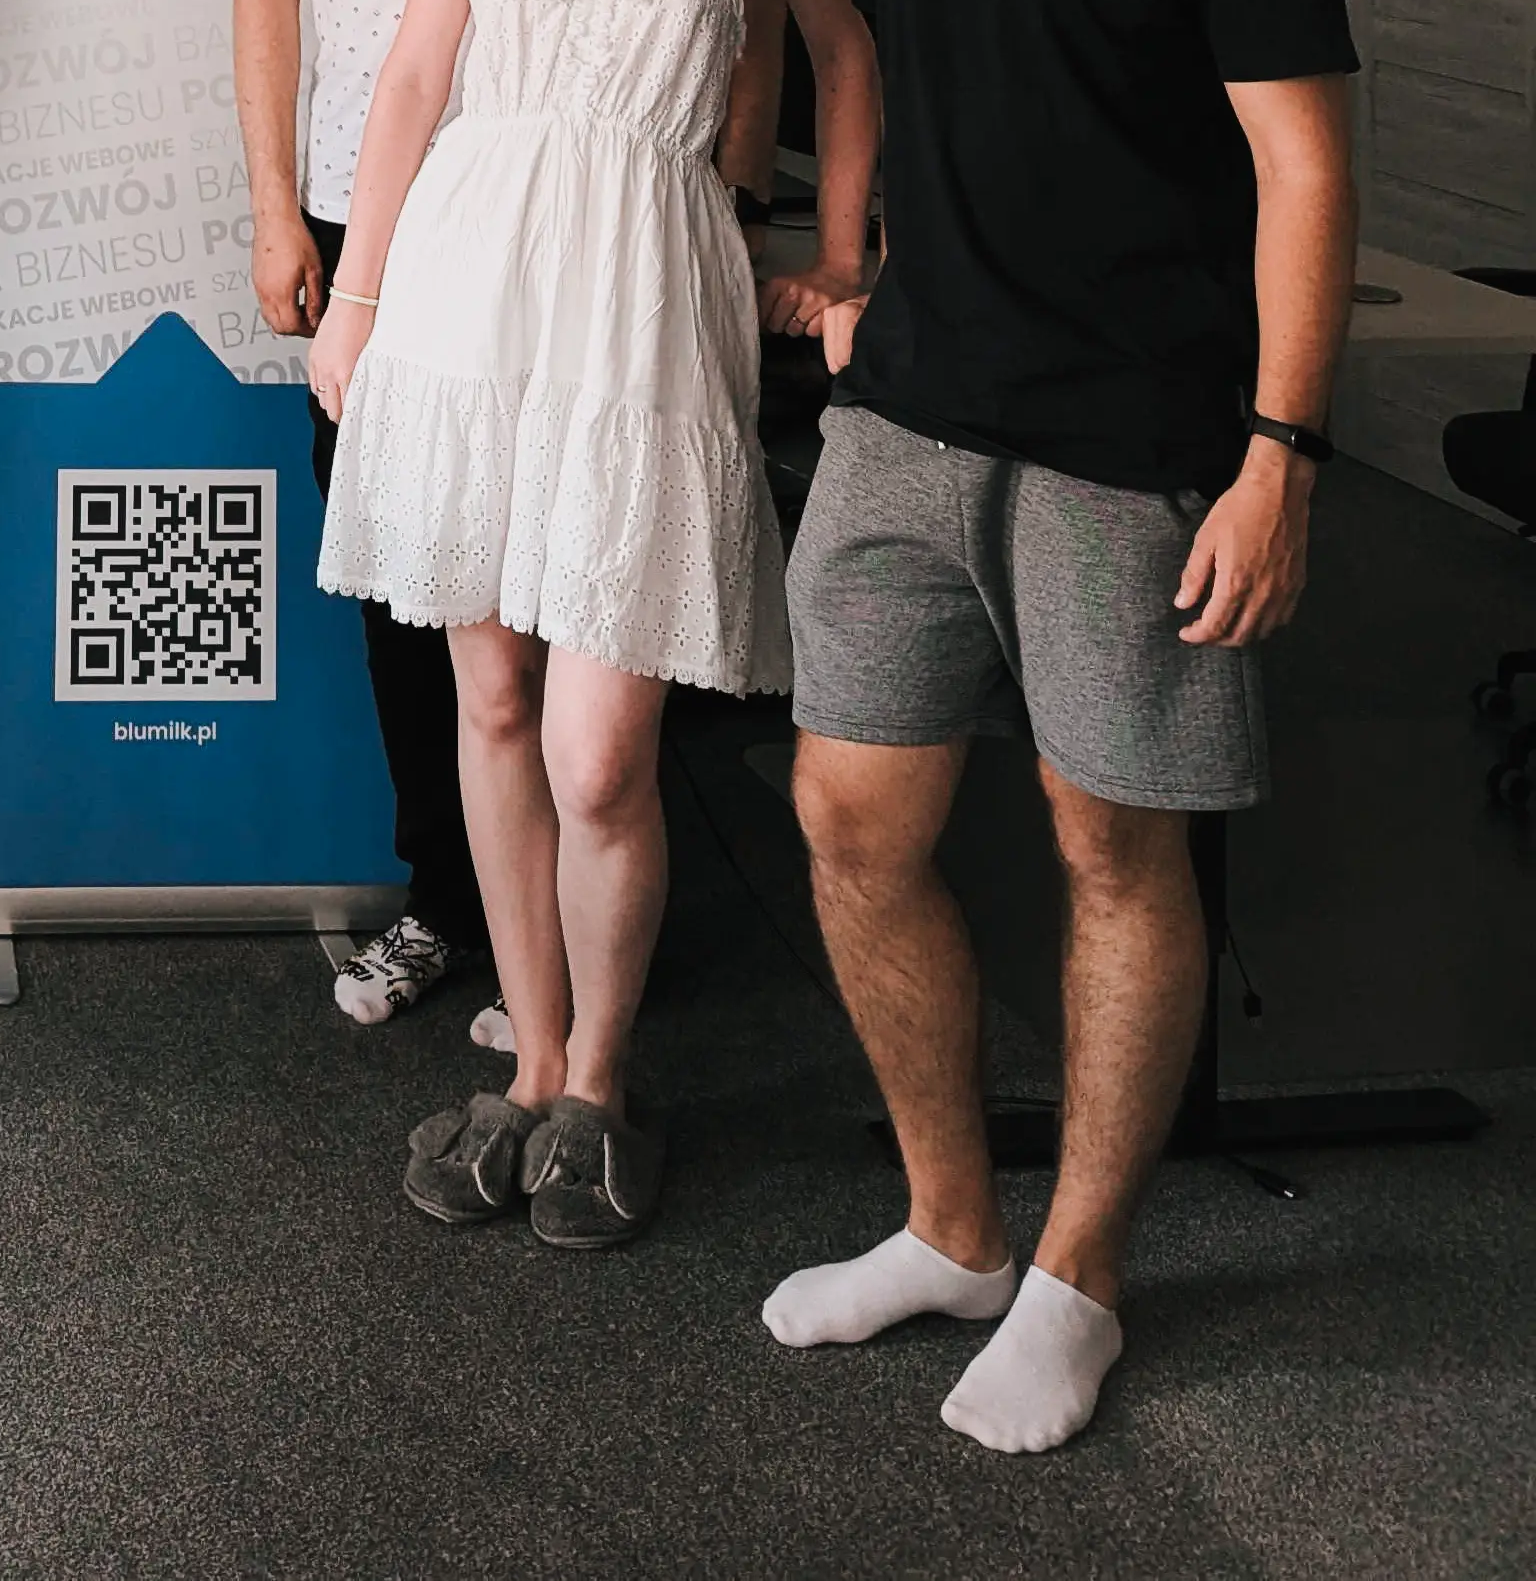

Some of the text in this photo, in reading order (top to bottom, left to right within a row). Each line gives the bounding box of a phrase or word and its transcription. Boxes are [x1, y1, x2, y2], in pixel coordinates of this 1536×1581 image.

[58, 138, 175, 176] WEBOWE
[16, 227, 185, 287] BIZNESU
[80, 280, 196, 317] WEBOWE
[114, 721, 217, 746] blumilk.pl
